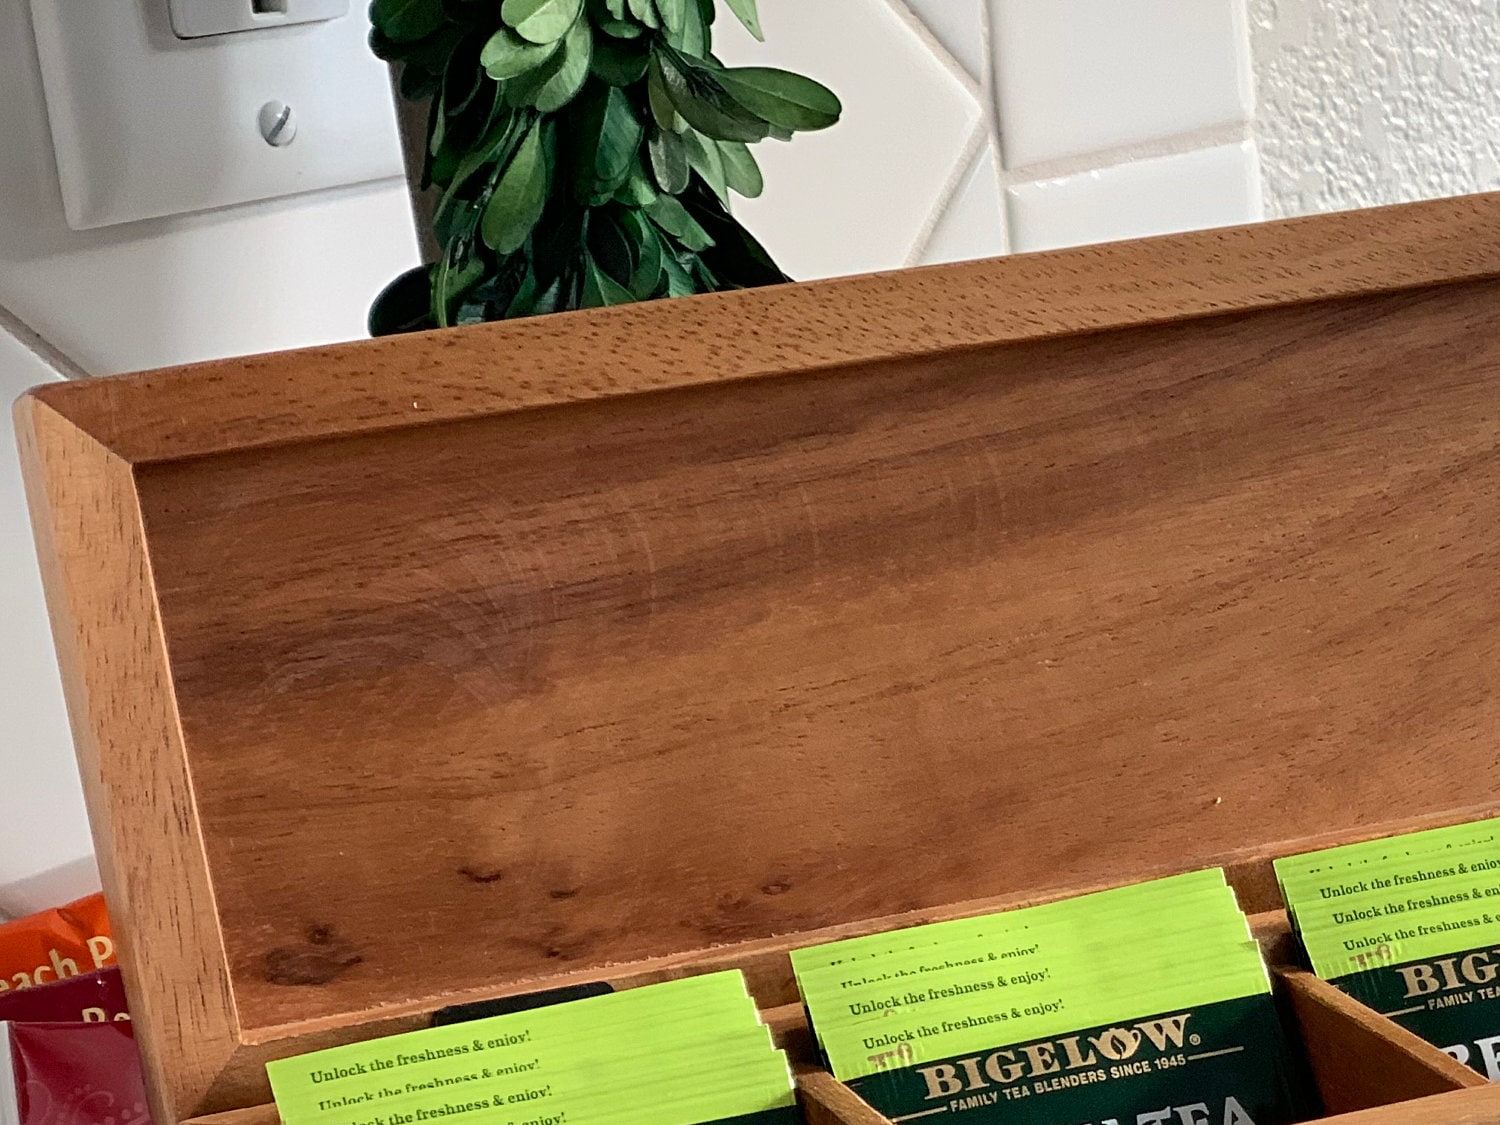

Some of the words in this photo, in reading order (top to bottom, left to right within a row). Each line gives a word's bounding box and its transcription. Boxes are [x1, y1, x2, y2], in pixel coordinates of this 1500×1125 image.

[1320, 880, 1369, 899] Unlock
[1370, 876, 1392, 890] the
[1394, 865, 1456, 886] freshness
[1458, 863, 1469, 874] &
[1333, 905, 1382, 925] Unlock
[1384, 901, 1406, 914] the
[1407, 890, 1470, 911] freshness
[1472, 888, 1482, 899] &
[1343, 931, 1393, 951] Unlock
[1395, 926, 1416, 940] the
[1418, 915, 1481, 936] freshness
[1483, 913, 1493, 924] &
[849, 996, 901, 1016] Unlock
[903, 991, 926, 1005] the
[929, 978, 995, 1001] freshness
[997, 976, 1008, 987] &
[1011, 968, 1051, 989] enjoy!
[1428, 990, 1474, 1011] FAMILY
[863, 1030, 914, 1050] Unlock
[917, 1024, 940, 1038] the
[942, 1011, 1008, 1033] freshness
[1011, 1008, 1022, 1018] &
[1025, 998, 1065, 1020] enjoy!
[310, 1063, 367, 1083] Unlock
[369, 1057, 394, 1072] the
[397, 1043, 469, 1066] freshness
[473, 1039, 484, 1051] &
[488, 1030, 531, 1048] enjoy!
[916, 1013, 1192, 1101] BIGELOW
[389, 1113, 413, 1125] the
[416, 1098, 489, 1121] freshness
[493, 1094, 504, 1106] &
[507, 1085, 552, 1103] enjoy!
[950, 1090, 998, 1113] FAMILY
[1002, 1084, 1031, 1099] TEA
[1035, 1069, 1107, 1094] BLENDERS
[1110, 1060, 1152, 1078] SINCE
[1155, 1054, 1186, 1071] 1945
